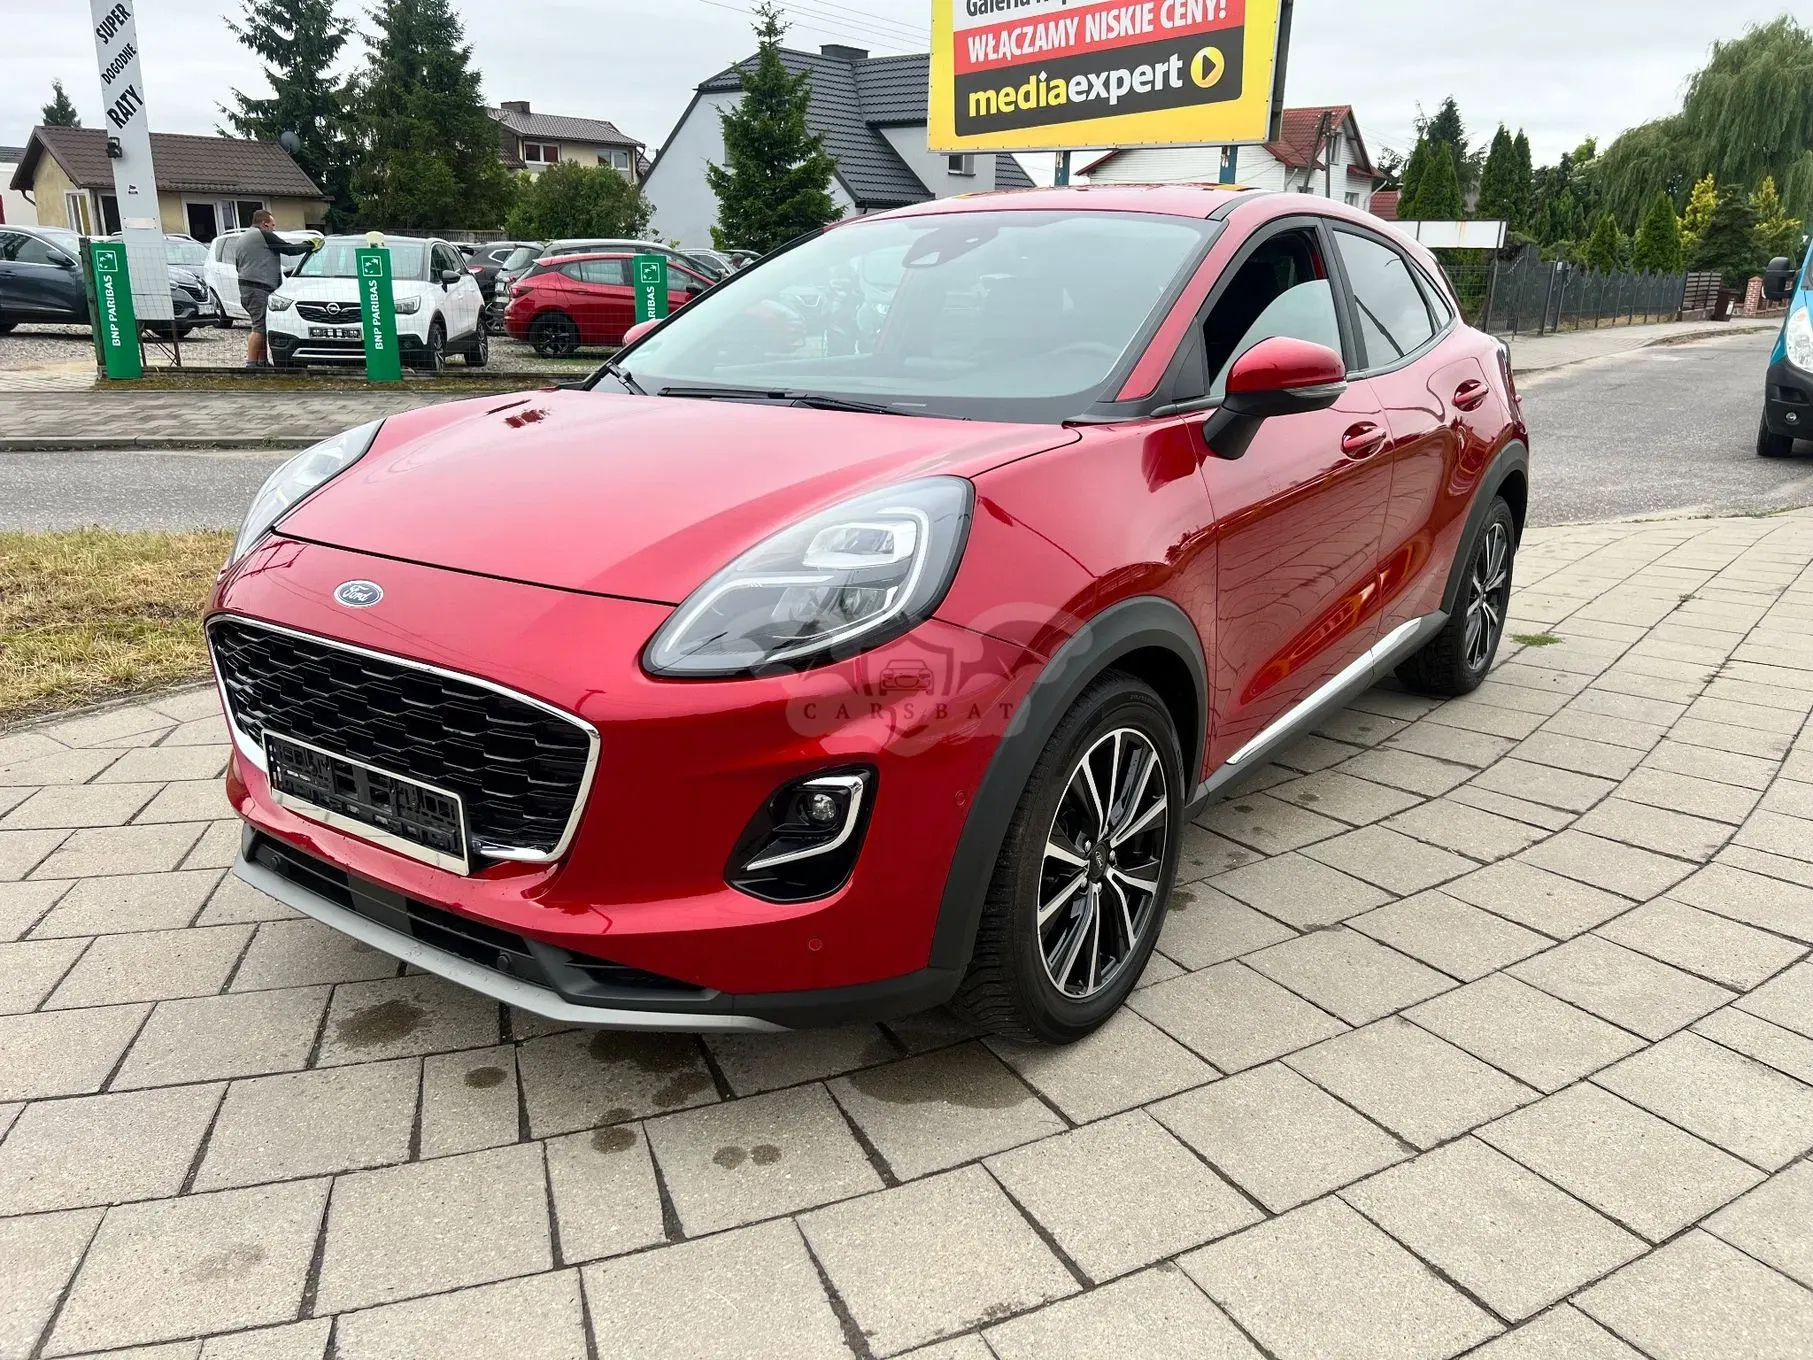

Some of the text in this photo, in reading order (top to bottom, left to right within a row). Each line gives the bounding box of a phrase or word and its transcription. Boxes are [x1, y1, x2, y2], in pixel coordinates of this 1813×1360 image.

[96, 3, 132, 45] SUPER
[967, 0, 1227, 64] WŁĄCZAMY NISKIE CENY!
[100, 42, 137, 86] DOGODNE
[968, 53, 1184, 117] mediaexpert
[106, 84, 144, 130] RATY
[103, 275, 121, 347] BNP PARIBAS
[368, 279, 384, 350] BNP PARIBAS
[646, 285, 657, 320] RIBAS
